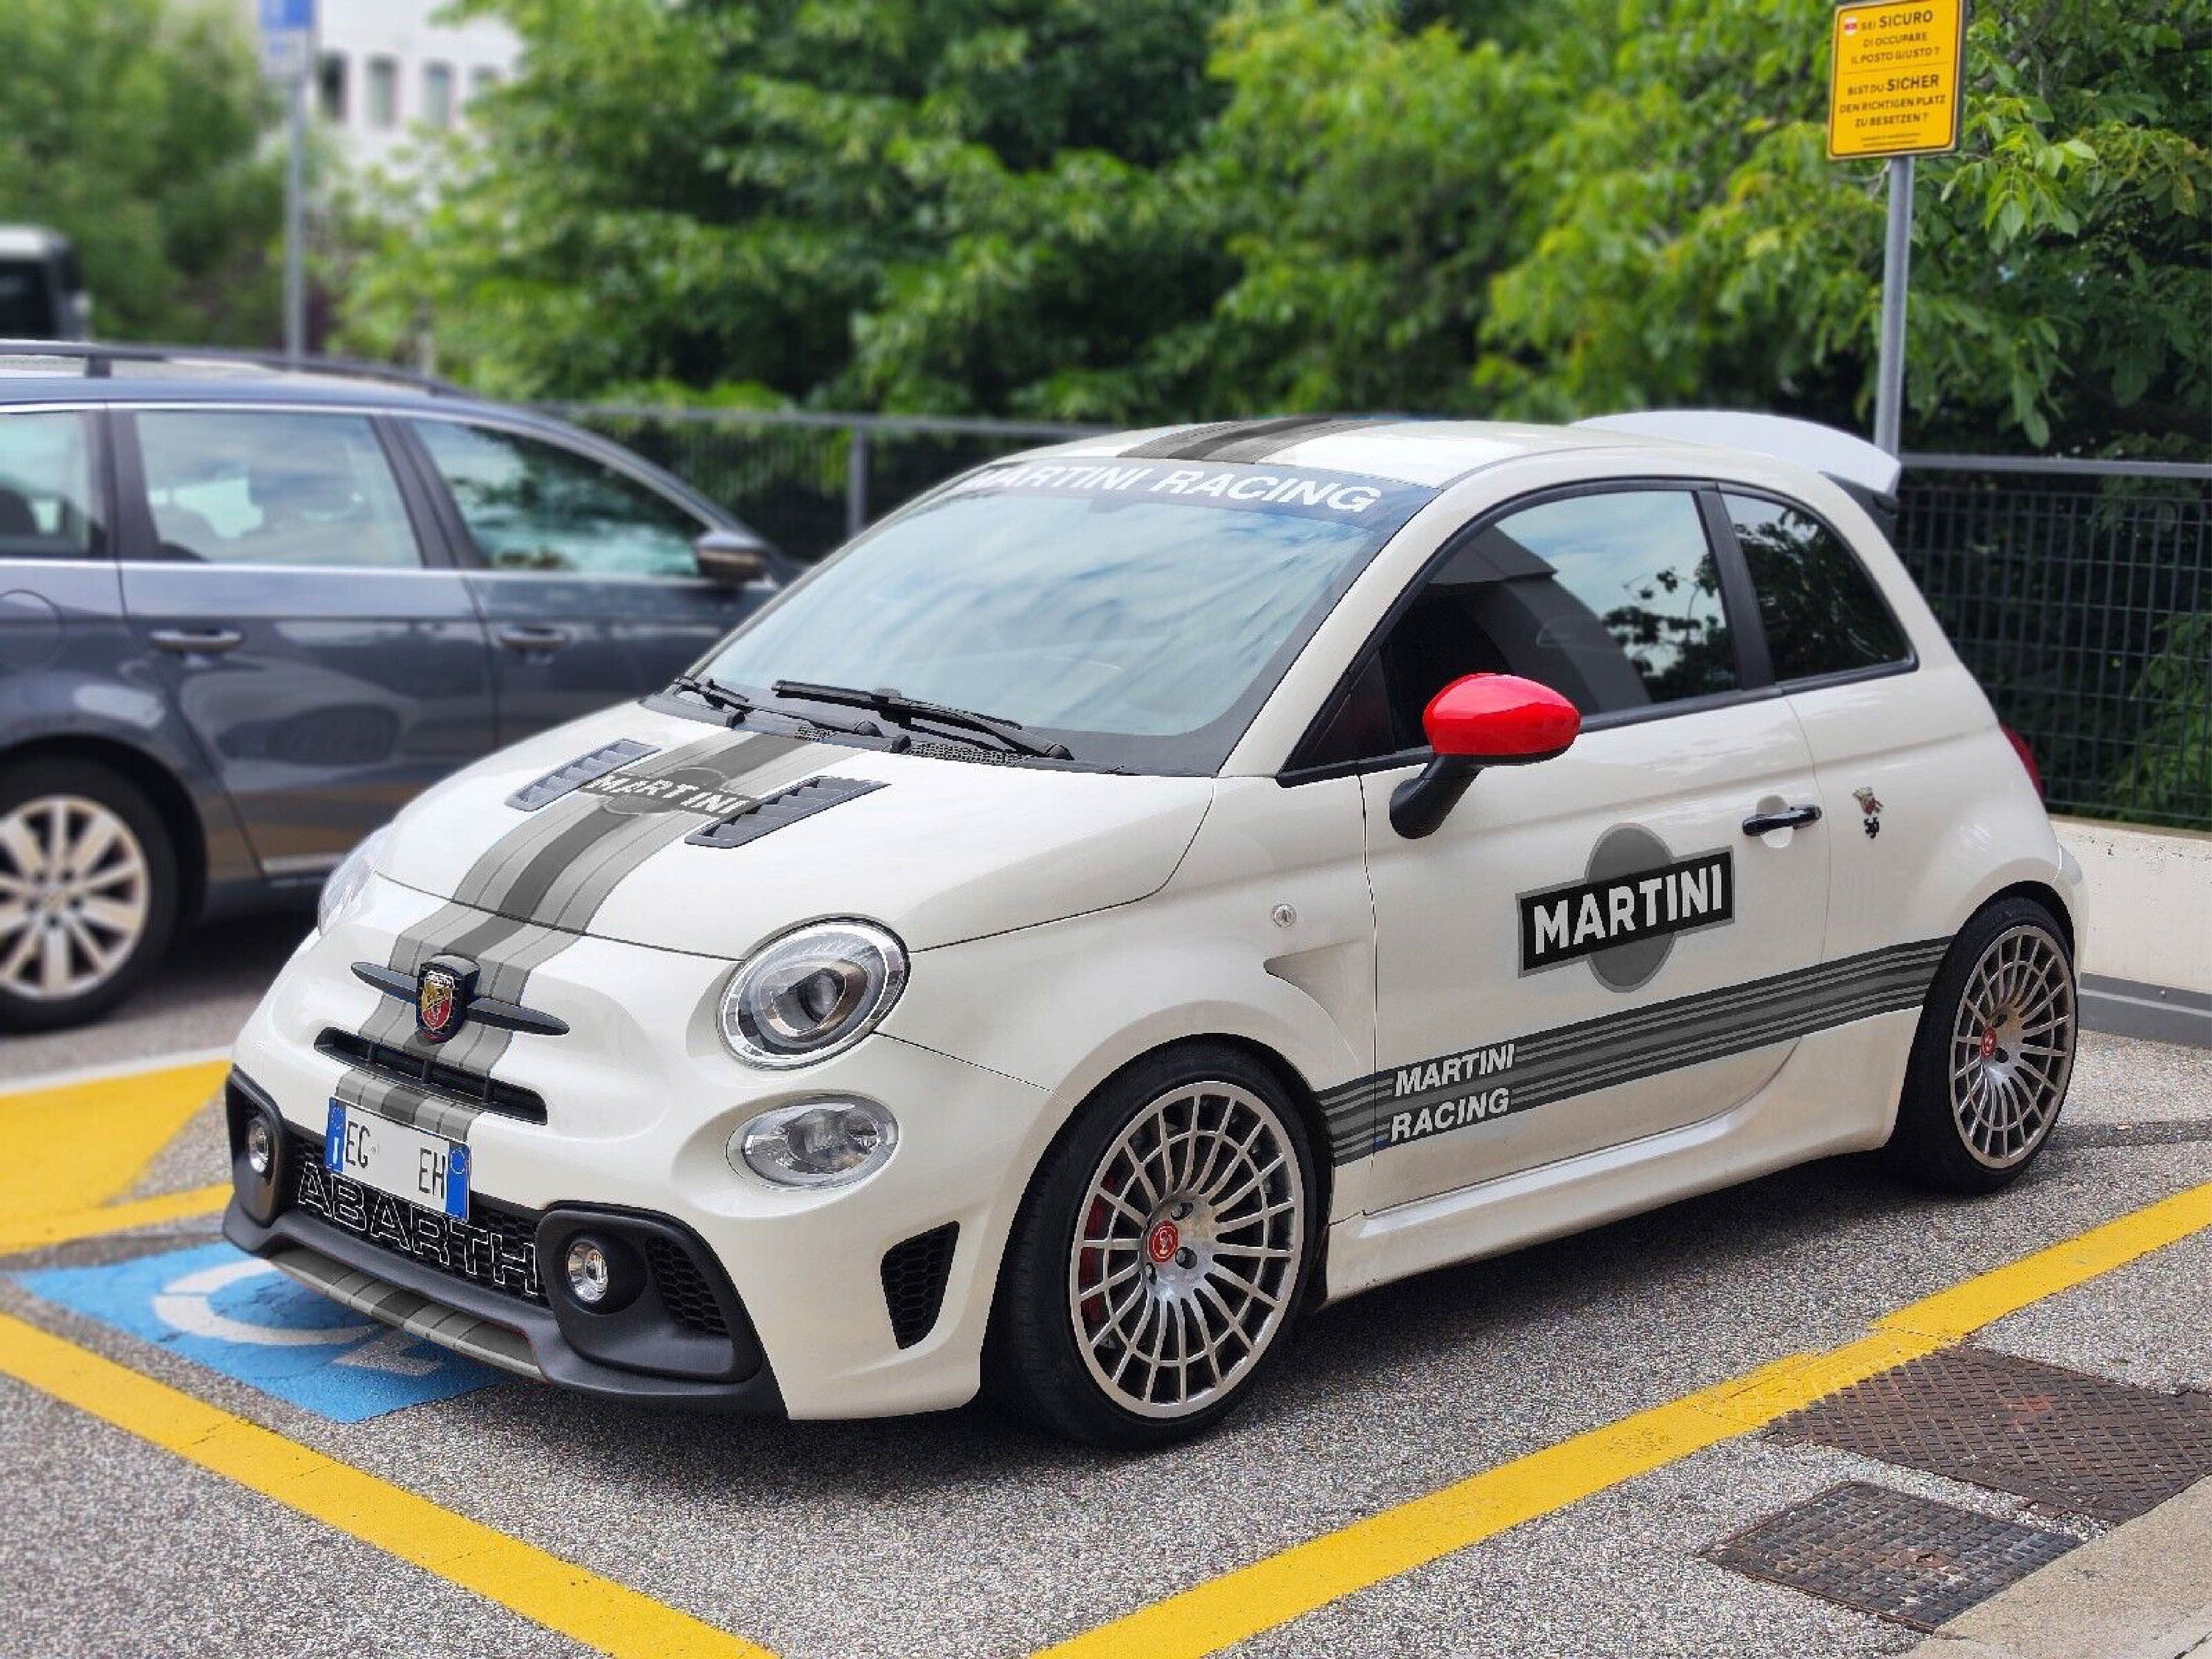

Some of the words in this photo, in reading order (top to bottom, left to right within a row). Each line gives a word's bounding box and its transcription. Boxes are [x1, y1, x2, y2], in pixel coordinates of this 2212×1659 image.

[1875, 32, 1928, 46] OCCUPARE
[1879, 10, 1933, 28] SICURO
[1862, 52, 1893, 63] POSTO
[1895, 47, 1933, 60] GIUSTO
[1887, 74, 1939, 91] SICHER
[1869, 113, 1921, 127] BESETZEN
[1149, 470, 1382, 513] RACING
[585, 774, 750, 814] MARTINI
[1534, 863, 1722, 955] MARTINI
[1394, 1043, 1514, 1097] MARTINI
[1390, 1088, 1509, 1142] RACING
[345, 1120, 371, 1169] EG
[418, 1146, 446, 1200] EH
[298, 1161, 539, 1296] ABARTH
